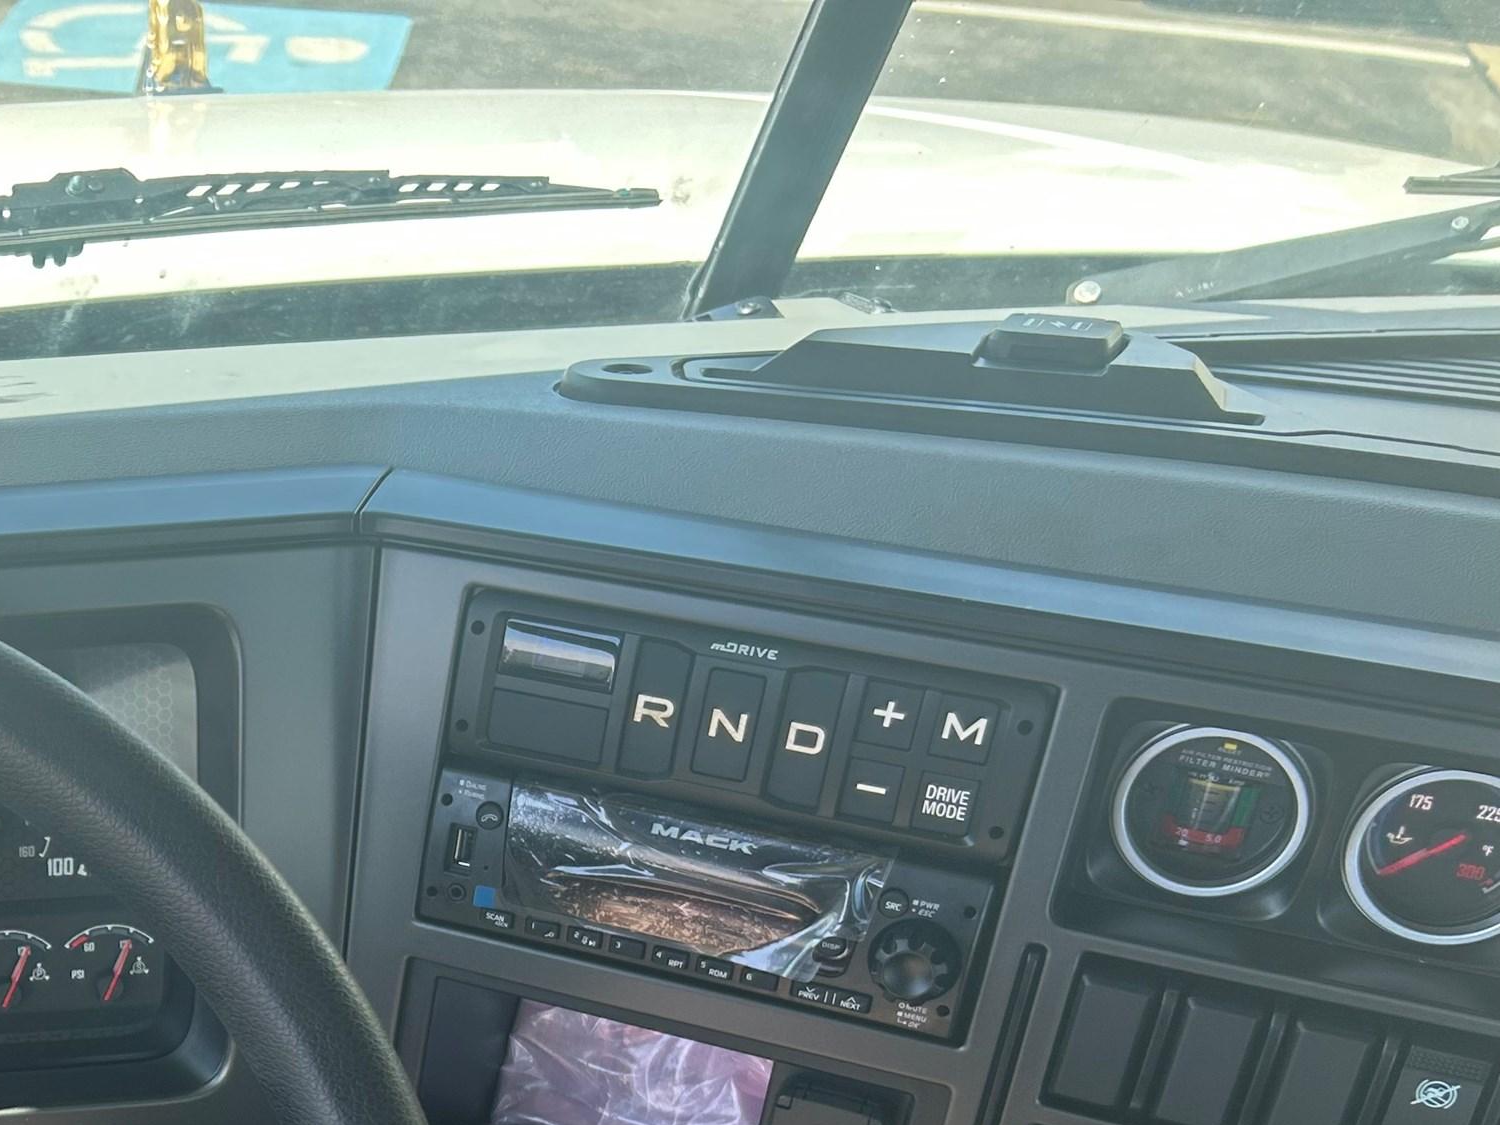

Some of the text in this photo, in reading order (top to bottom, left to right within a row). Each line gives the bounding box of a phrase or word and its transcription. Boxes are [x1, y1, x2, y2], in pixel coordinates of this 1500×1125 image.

[710, 641, 779, 660] mDRIVE
[632, 694, 674, 729] R
[708, 708, 749, 743] N
[941, 712, 989, 746] M
[785, 721, 827, 755] D
[1179, 755, 1217, 769] FILTER
[925, 784, 971, 806] DRIVE
[1409, 793, 1434, 811] 175
[921, 800, 968, 821] MODE
[650, 822, 758, 856] MACK
[19, 846, 35, 858] 160
[47, 857, 74, 877] 100
[885, 900, 902, 912] SRC
[485, 911, 506, 923] SCAN
[573, 930, 580, 939] 2
[83, 942, 96, 953] 60
[615, 940, 622, 949] 3
[668, 958, 684, 969] RPT
[71, 969, 85, 980] PSI
[708, 967, 728, 979] RDM
[746, 972, 753, 981] 6
[840, 999, 861, 1011] NEXT
